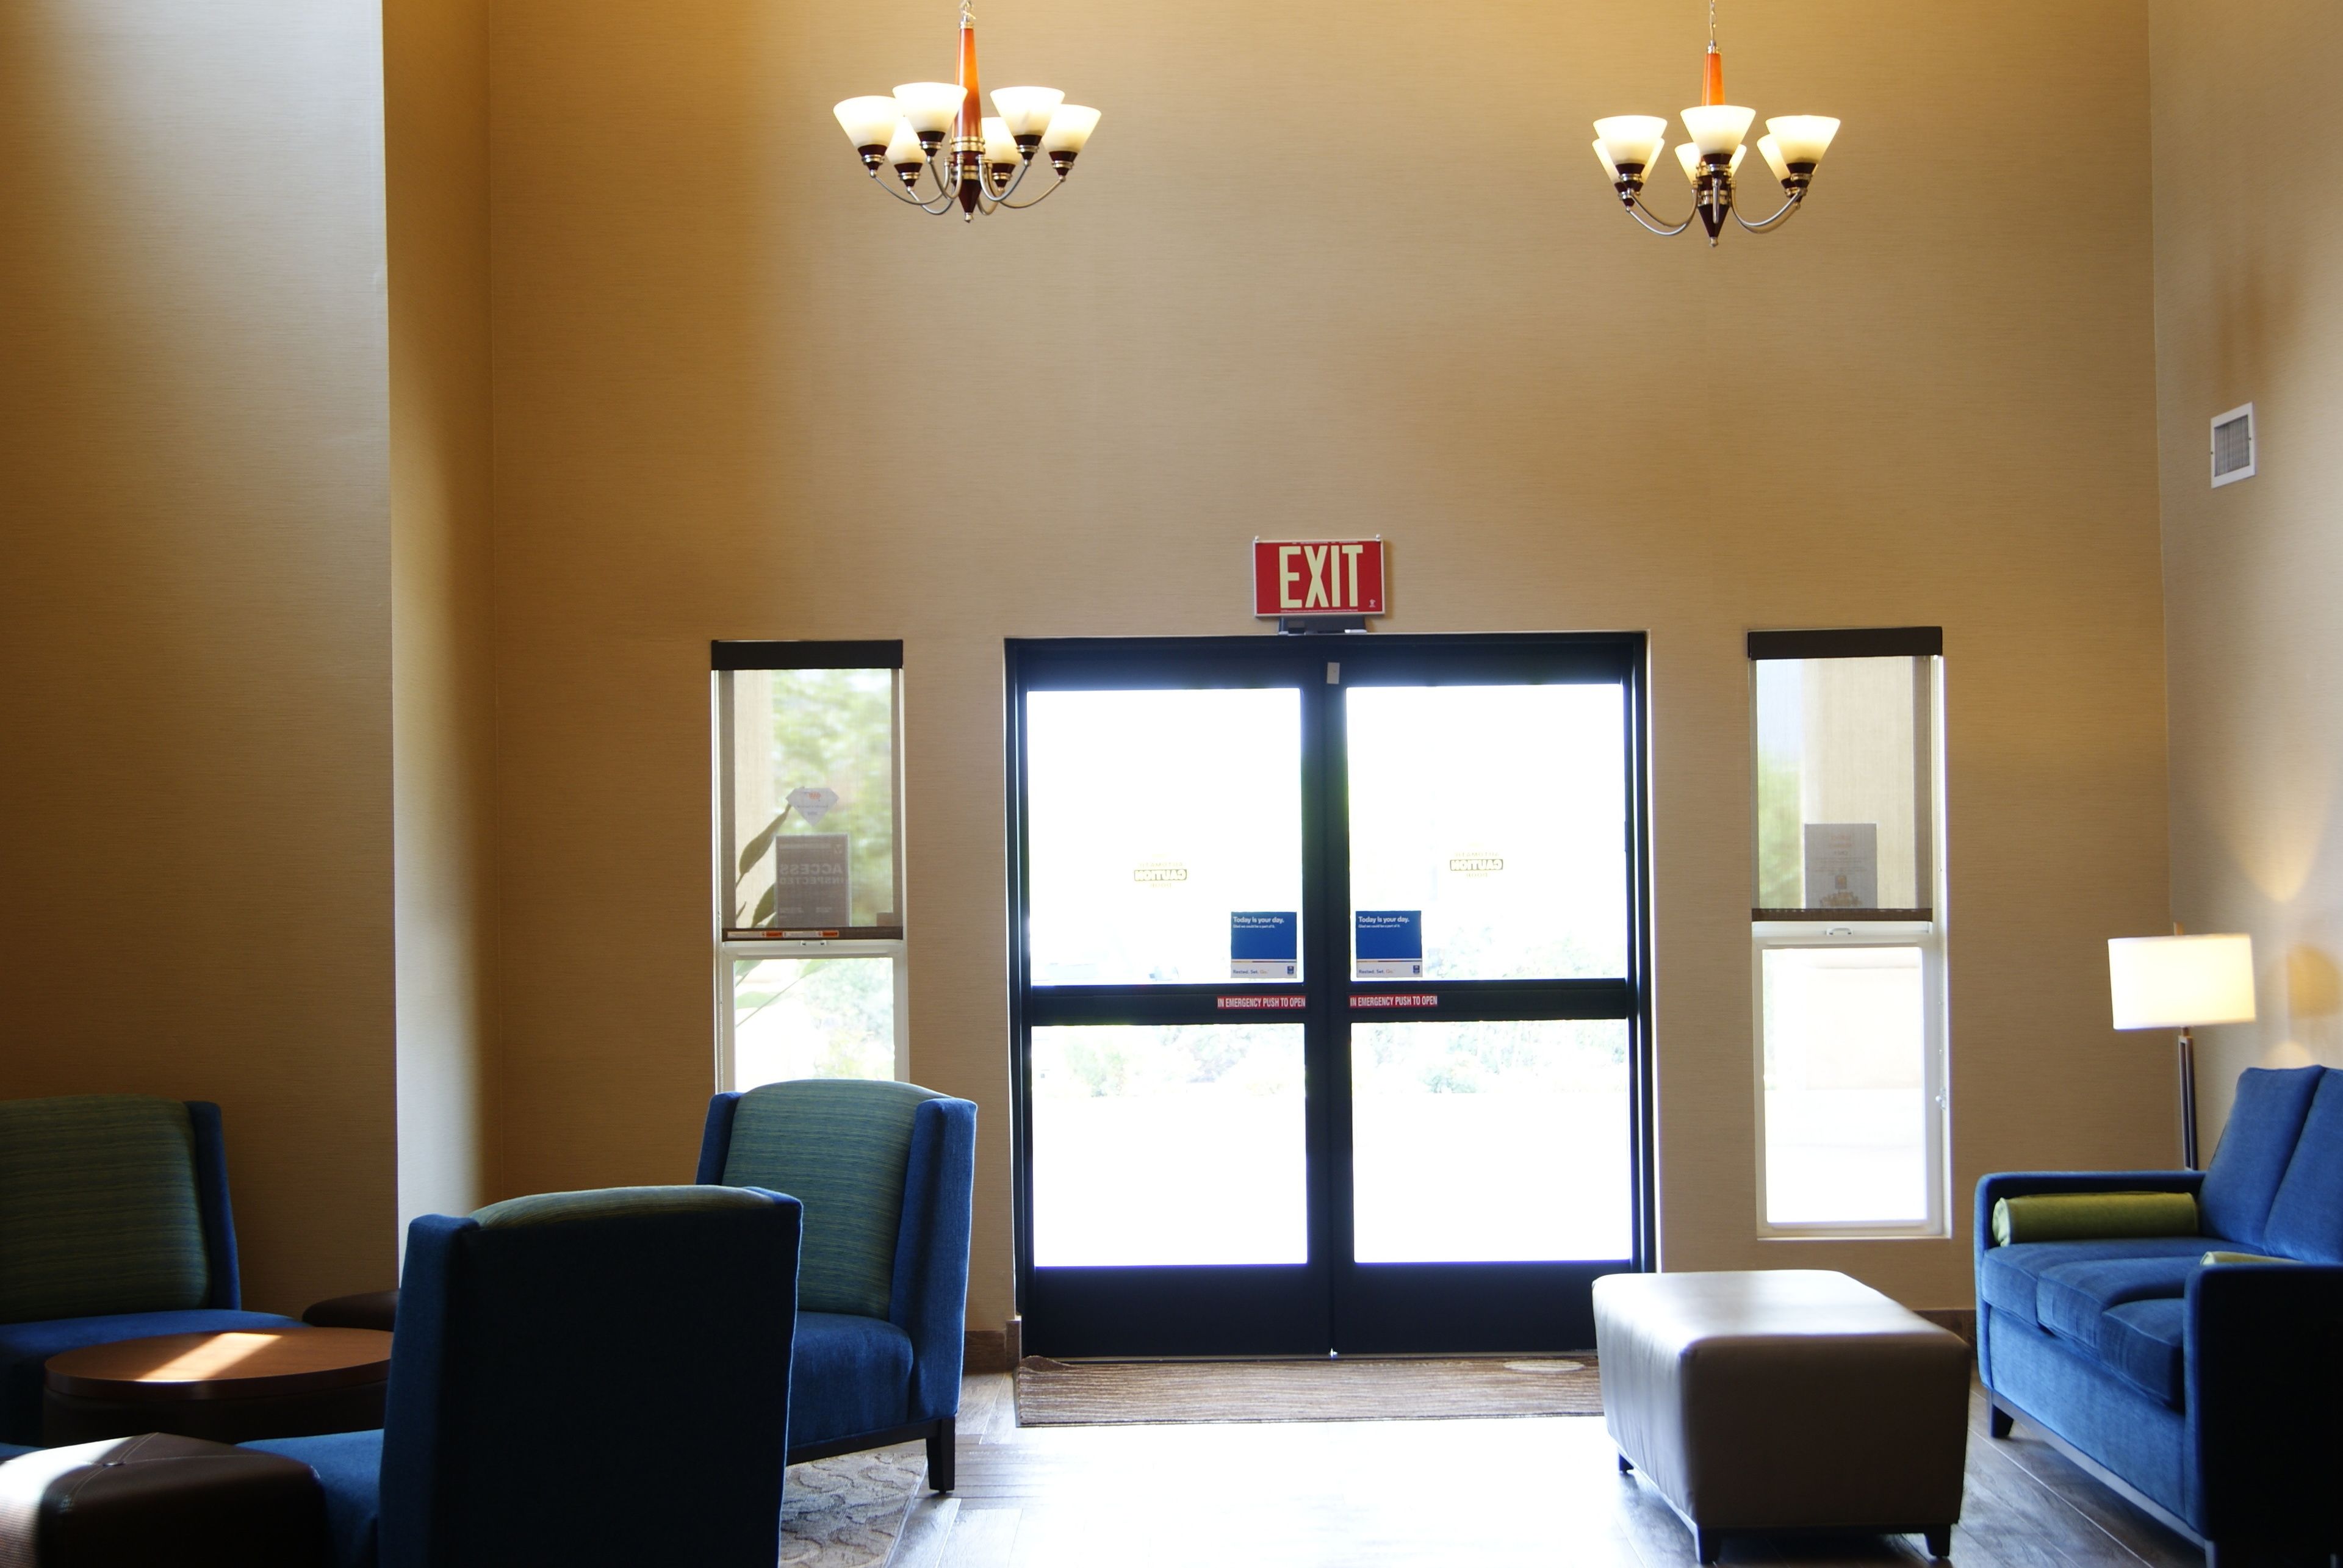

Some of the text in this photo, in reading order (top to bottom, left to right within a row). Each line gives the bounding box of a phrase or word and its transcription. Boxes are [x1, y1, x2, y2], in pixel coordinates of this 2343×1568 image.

[1279, 545, 1363, 608] EXIT
[1217, 998, 1306, 1007] IN EMERGENCY PUSH TO OPEN
[1350, 996, 1438, 1006] IN EMERGENCY PUSH TO OPEN
